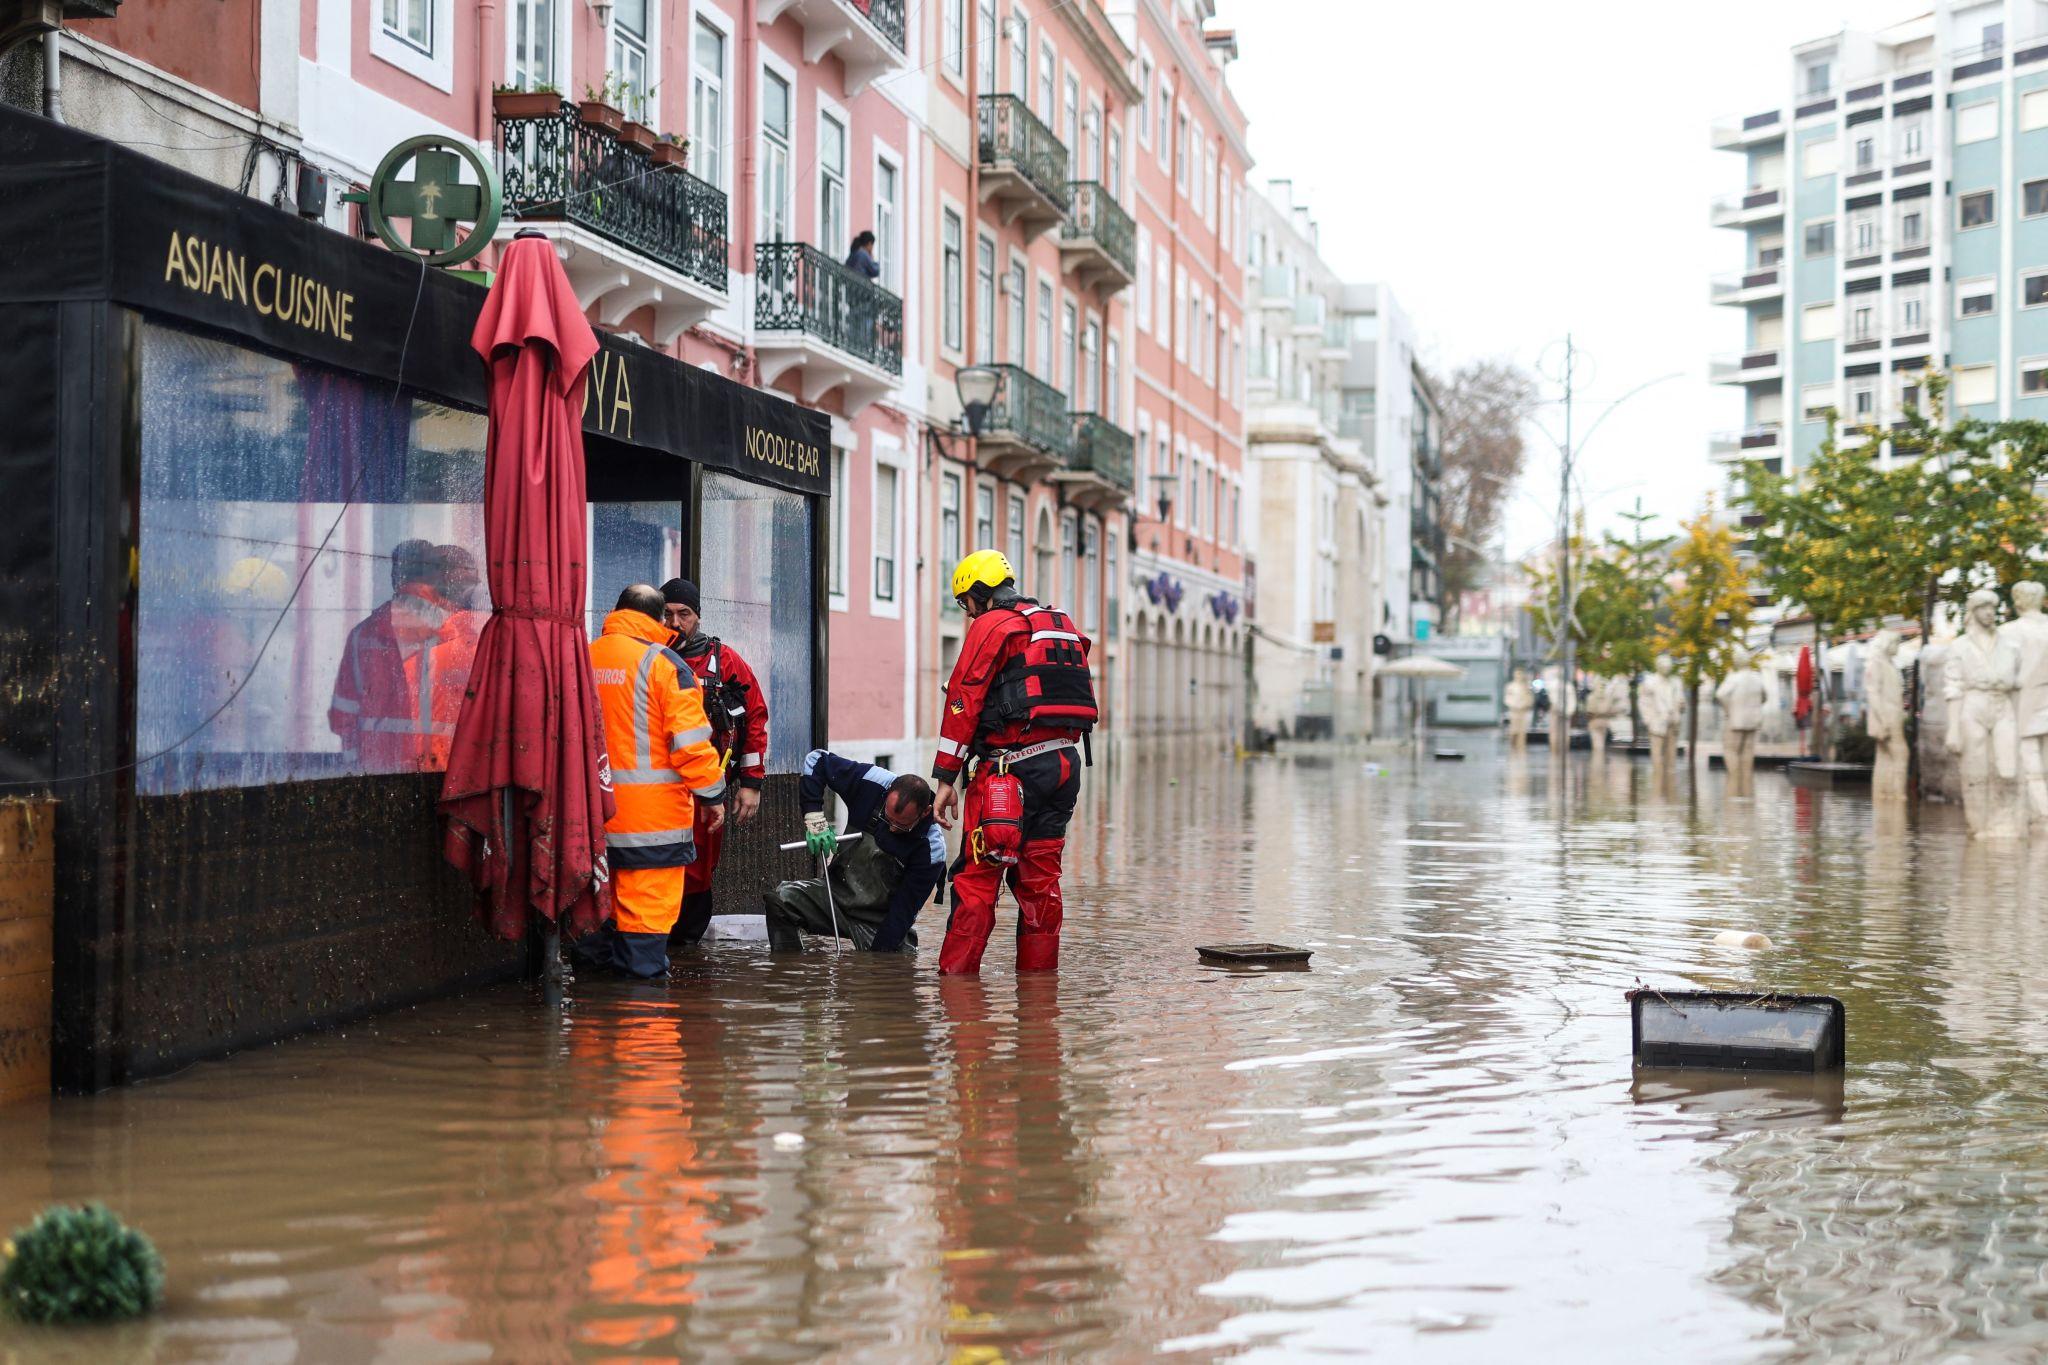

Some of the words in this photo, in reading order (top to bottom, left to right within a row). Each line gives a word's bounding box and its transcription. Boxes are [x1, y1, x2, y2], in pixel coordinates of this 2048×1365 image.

[165, 231, 248, 306] ASIAN
[252, 263, 354, 341] CUISINE
[581, 350, 632, 439] YA
[745, 425, 794, 470] NOODLE
[798, 442, 820, 477] BAR
